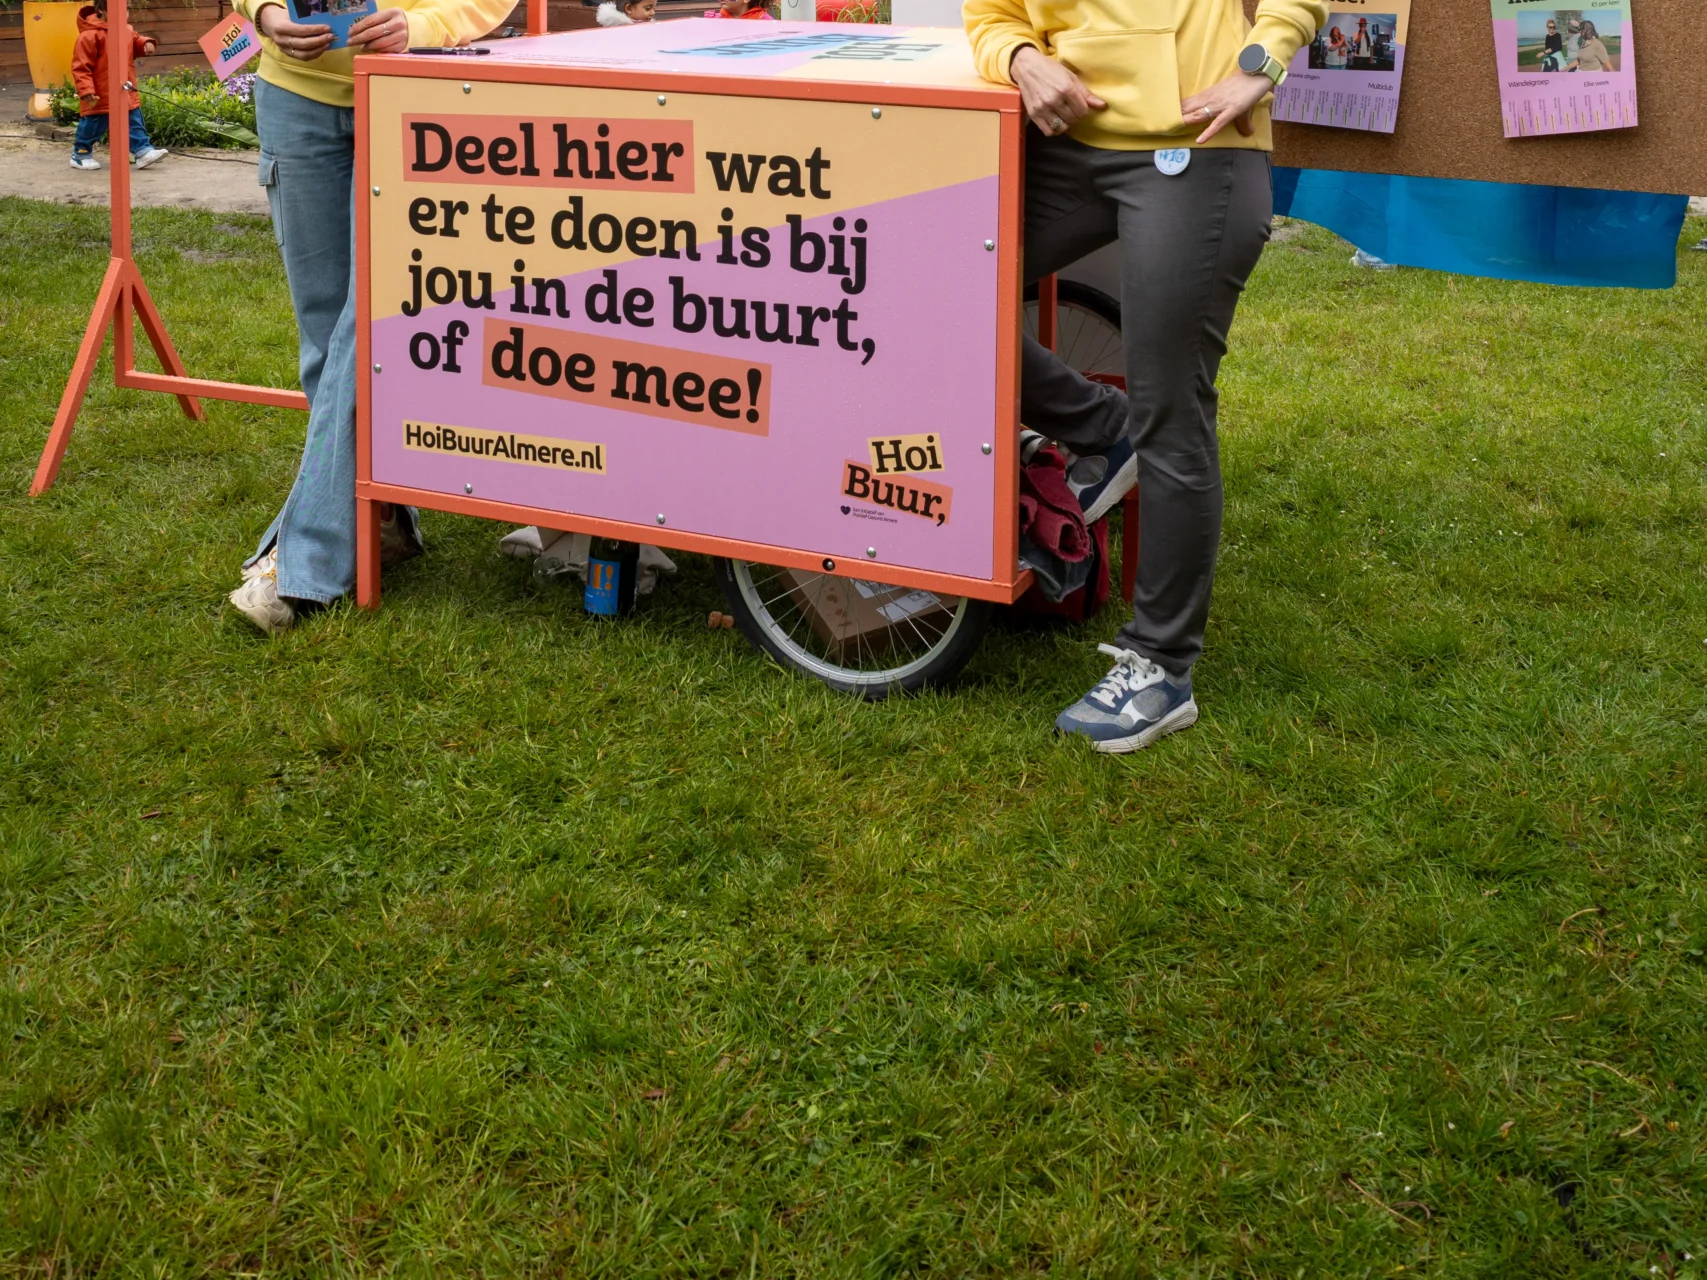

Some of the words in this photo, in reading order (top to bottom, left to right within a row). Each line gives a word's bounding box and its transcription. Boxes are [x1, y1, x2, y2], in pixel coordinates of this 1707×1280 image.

[221, 38, 251, 63] Buur,
[222, 24, 242, 48] Hoi
[1368, 82, 1394, 91] Multiclub
[1508, 79, 1550, 88] Wandelgroep
[410, 122, 540, 177] Deel
[553, 123, 684, 182] hier
[705, 147, 832, 200] wat
[408, 196, 470, 238] er
[481, 193, 536, 245] te
[551, 196, 702, 262] doen
[716, 206, 772, 269] is
[785, 214, 868, 295] bij
[401, 248, 496, 317] jou
[509, 258, 570, 319] in
[584, 270, 655, 327] de
[668, 276, 876, 366] buurt,
[408, 319, 470, 375] of
[490, 327, 595, 393] doe
[610, 367, 763, 424] mee!
[405, 423, 604, 471] HoiBuurAlmere.nl
[871, 435, 942, 473] Hoi
[844, 463, 946, 527] Buur,
